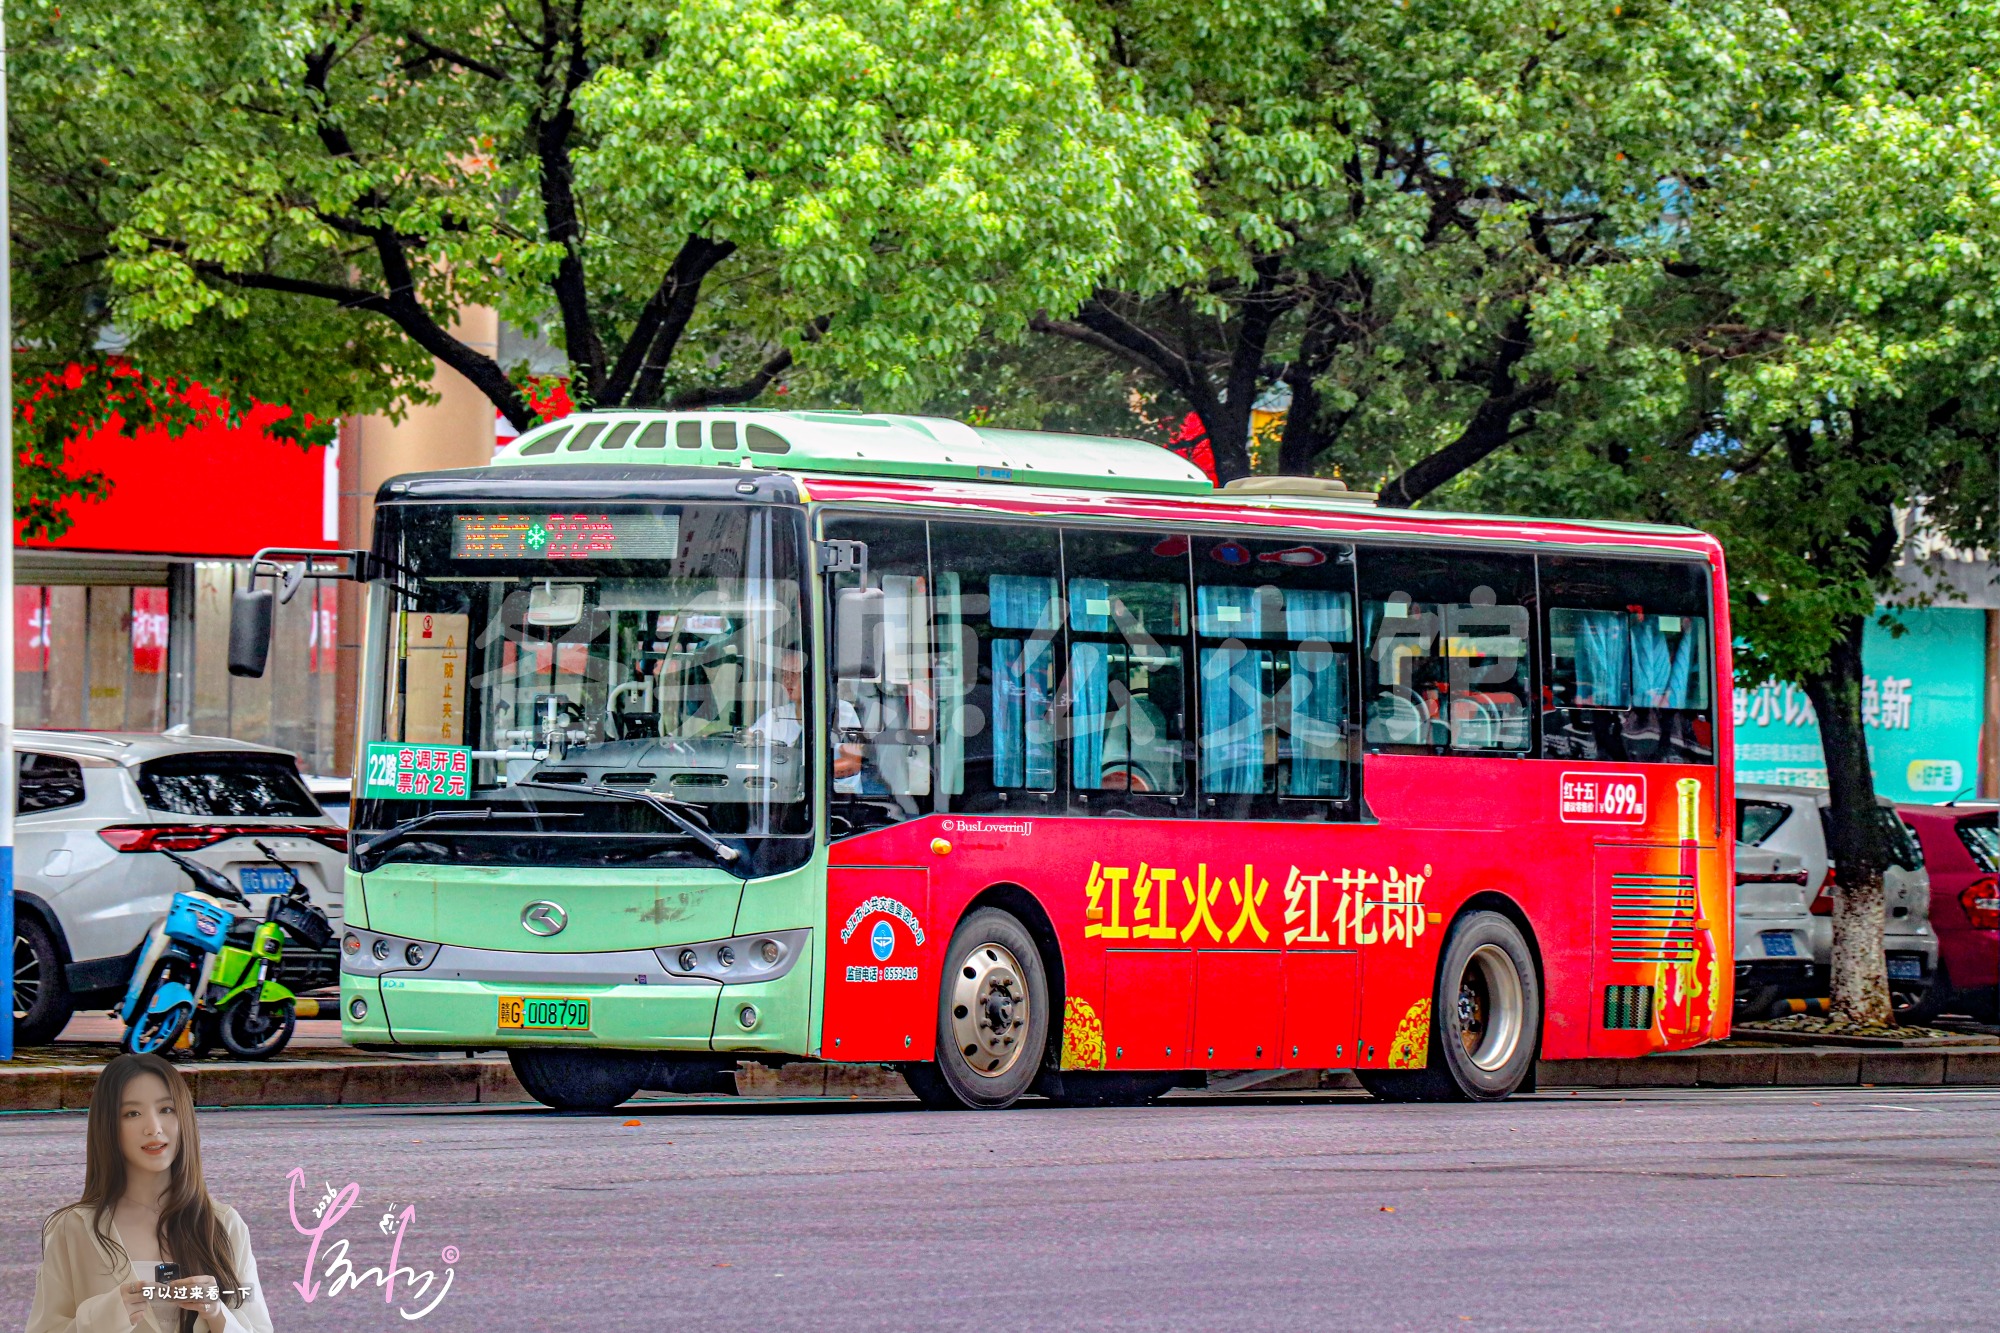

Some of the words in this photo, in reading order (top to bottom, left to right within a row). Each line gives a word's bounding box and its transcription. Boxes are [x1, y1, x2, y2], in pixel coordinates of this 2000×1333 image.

[441, 662, 455, 739] 防止夹伤
[368, 753, 397, 786] 22路
[399, 749, 467, 772] 空调开启
[396, 772, 466, 796] 票价2元
[841, 896, 926, 946] 九江市公共交通集团公司
[1085, 861, 1269, 943] 红红火火
[1284, 865, 1426, 948] 红花郎
